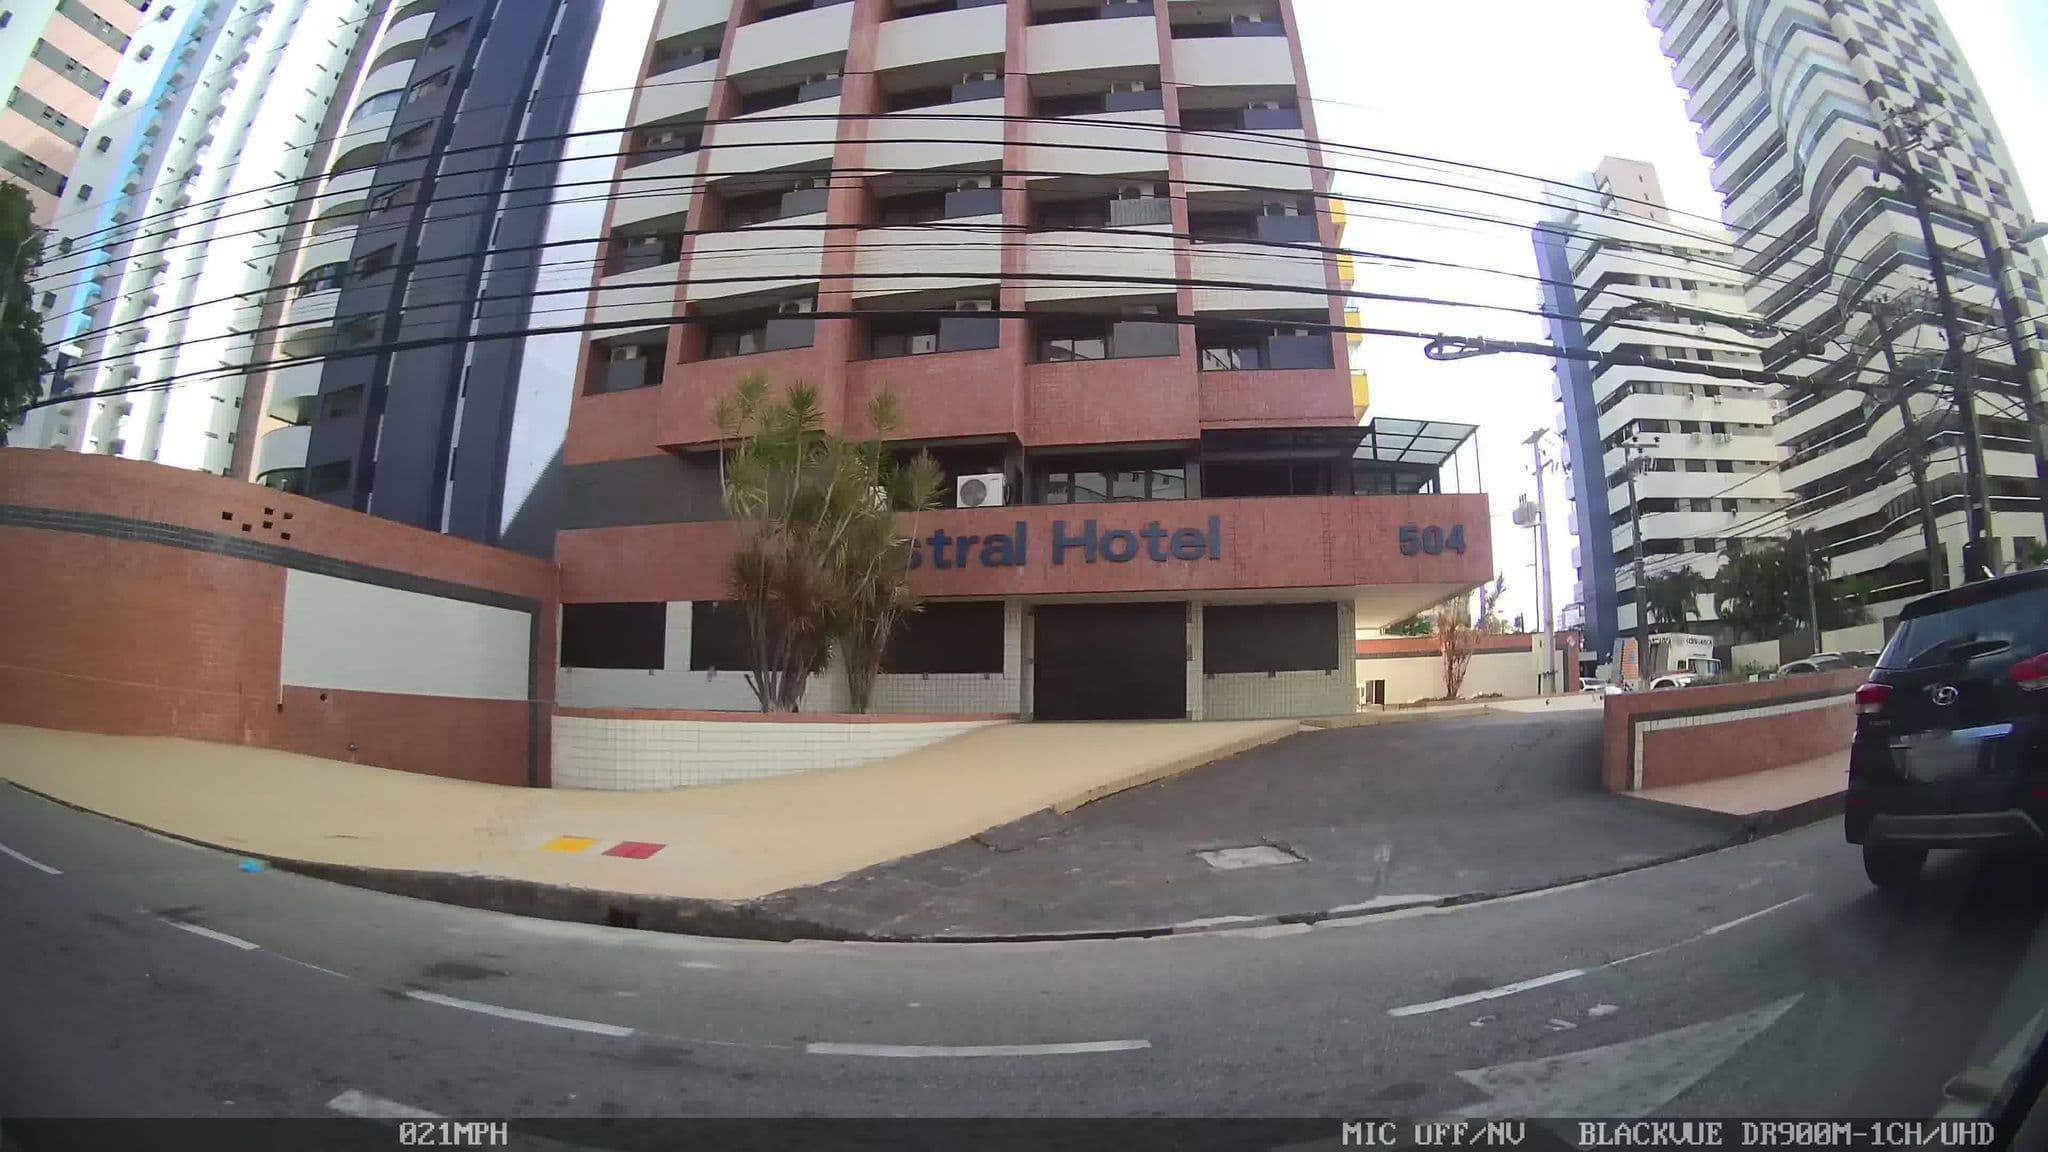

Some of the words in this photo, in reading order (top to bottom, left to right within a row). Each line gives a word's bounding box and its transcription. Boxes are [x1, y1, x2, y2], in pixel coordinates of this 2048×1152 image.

[901, 521, 1027, 571] stral
[1052, 515, 1221, 565] Hotel
[1399, 524, 1466, 557] 504
